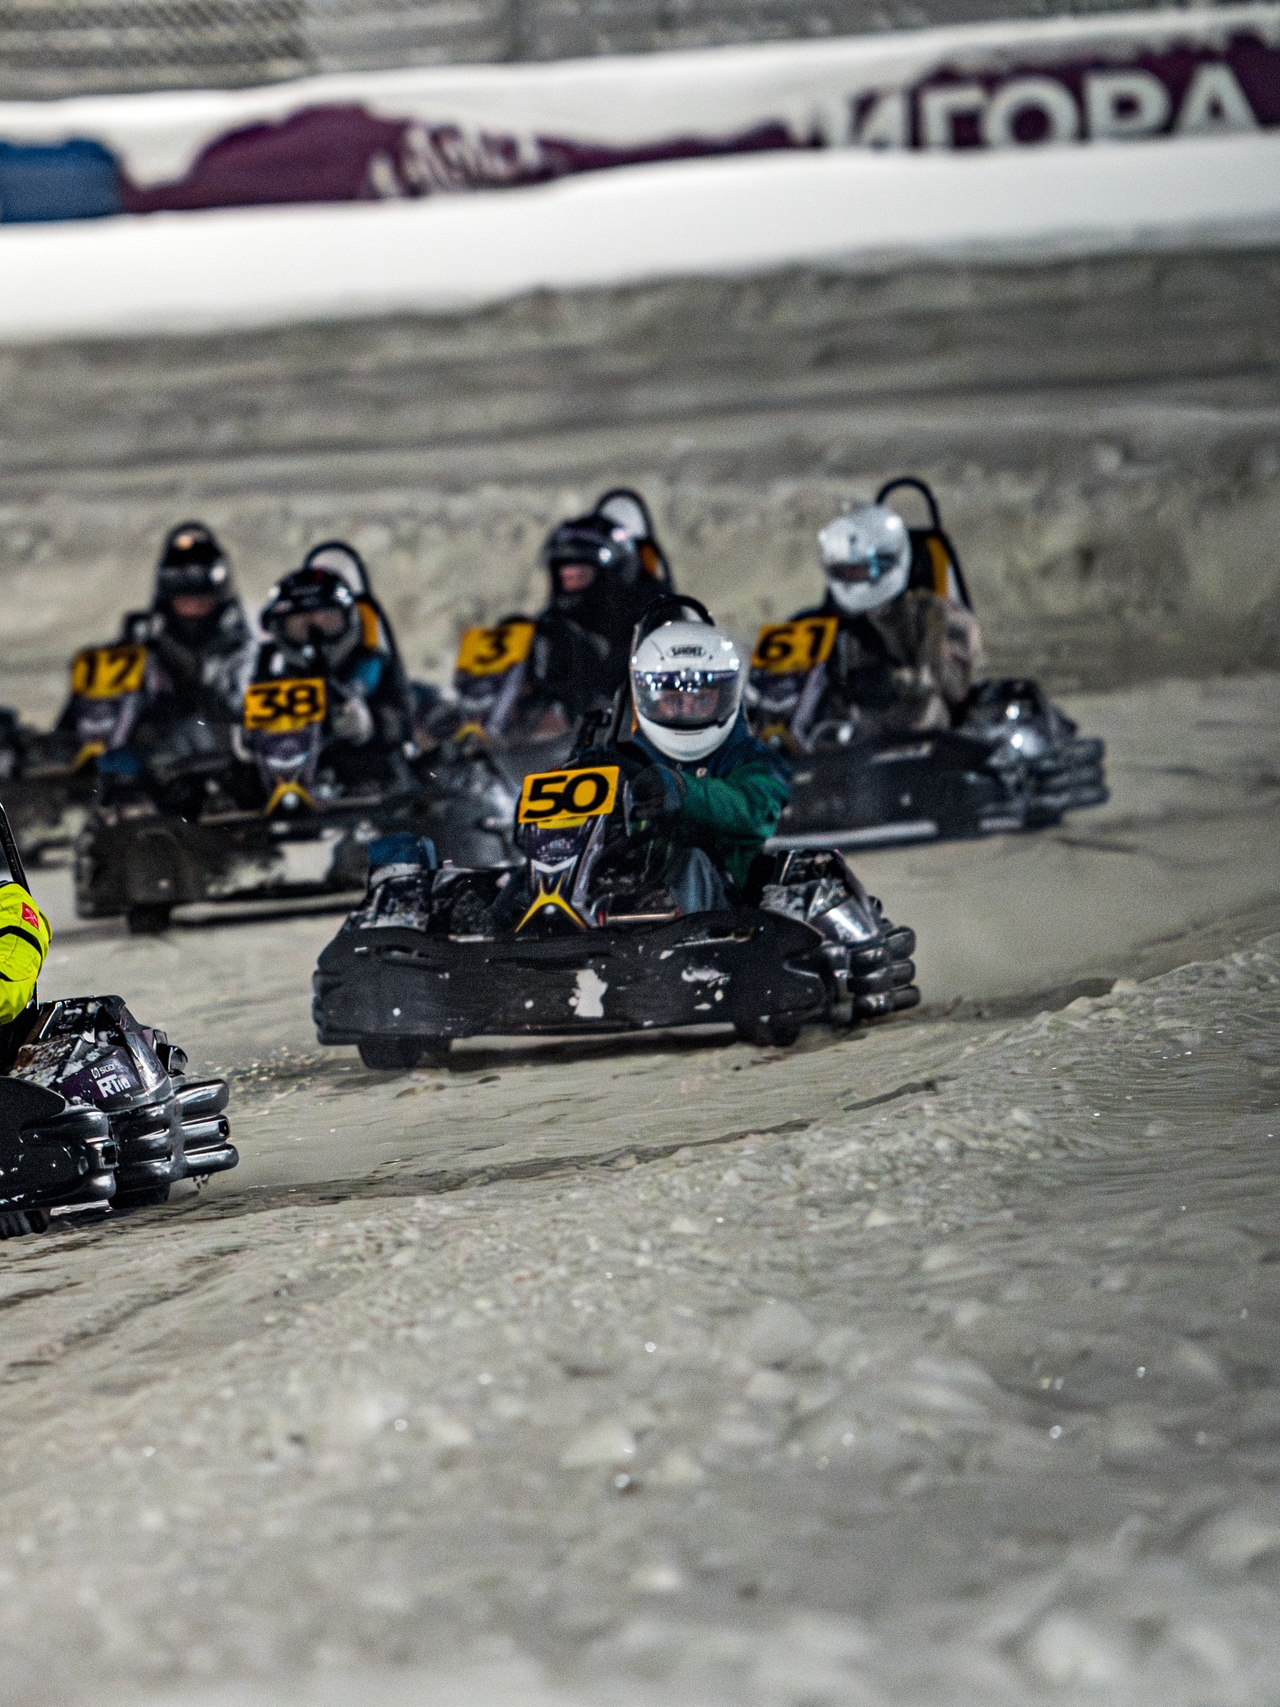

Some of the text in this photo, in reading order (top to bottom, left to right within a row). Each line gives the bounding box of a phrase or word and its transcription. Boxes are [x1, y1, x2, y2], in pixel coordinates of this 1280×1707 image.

[826, 62, 1260, 150] ИГОРА
[474, 626, 511, 665] 3
[758, 626, 825, 662] 61
[82, 649, 138, 689] 17
[250, 685, 320, 722] 38
[522, 772, 610, 819] 50
